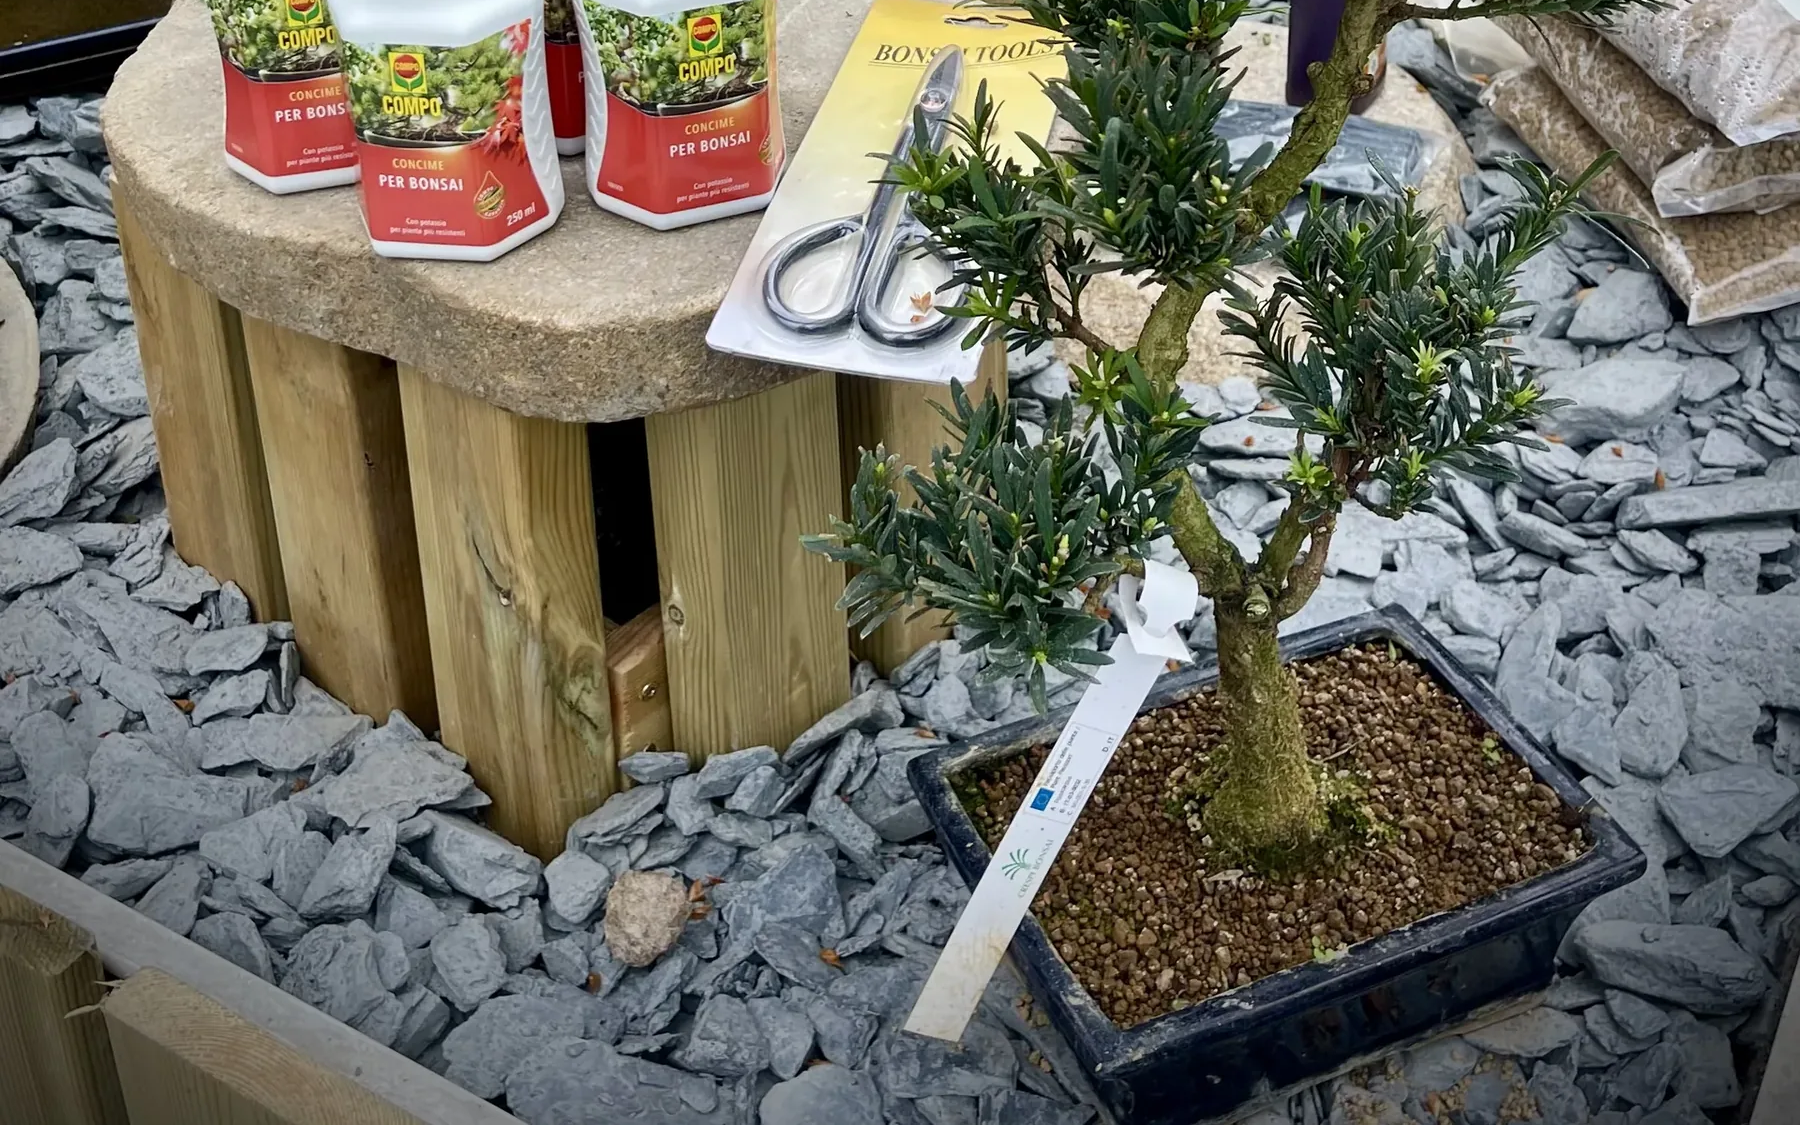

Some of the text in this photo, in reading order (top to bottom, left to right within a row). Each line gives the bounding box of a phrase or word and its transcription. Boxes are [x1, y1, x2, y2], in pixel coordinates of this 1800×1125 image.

[278, 25, 337, 50] COMPO
[976, 35, 1056, 63] TOOLS
[678, 54, 736, 82] COMPO
[289, 85, 342, 101] CONCIME
[275, 103, 346, 123] PER BONS
[382, 95, 441, 117] COMPO
[684, 116, 736, 135] CONCIME
[669, 142, 696, 157] PER
[700, 130, 751, 153] BONSAI
[392, 157, 444, 171] CONCIME
[378, 174, 464, 192] PER BONSAI
[506, 209, 524, 226] 250
[524, 201, 536, 217] ml
